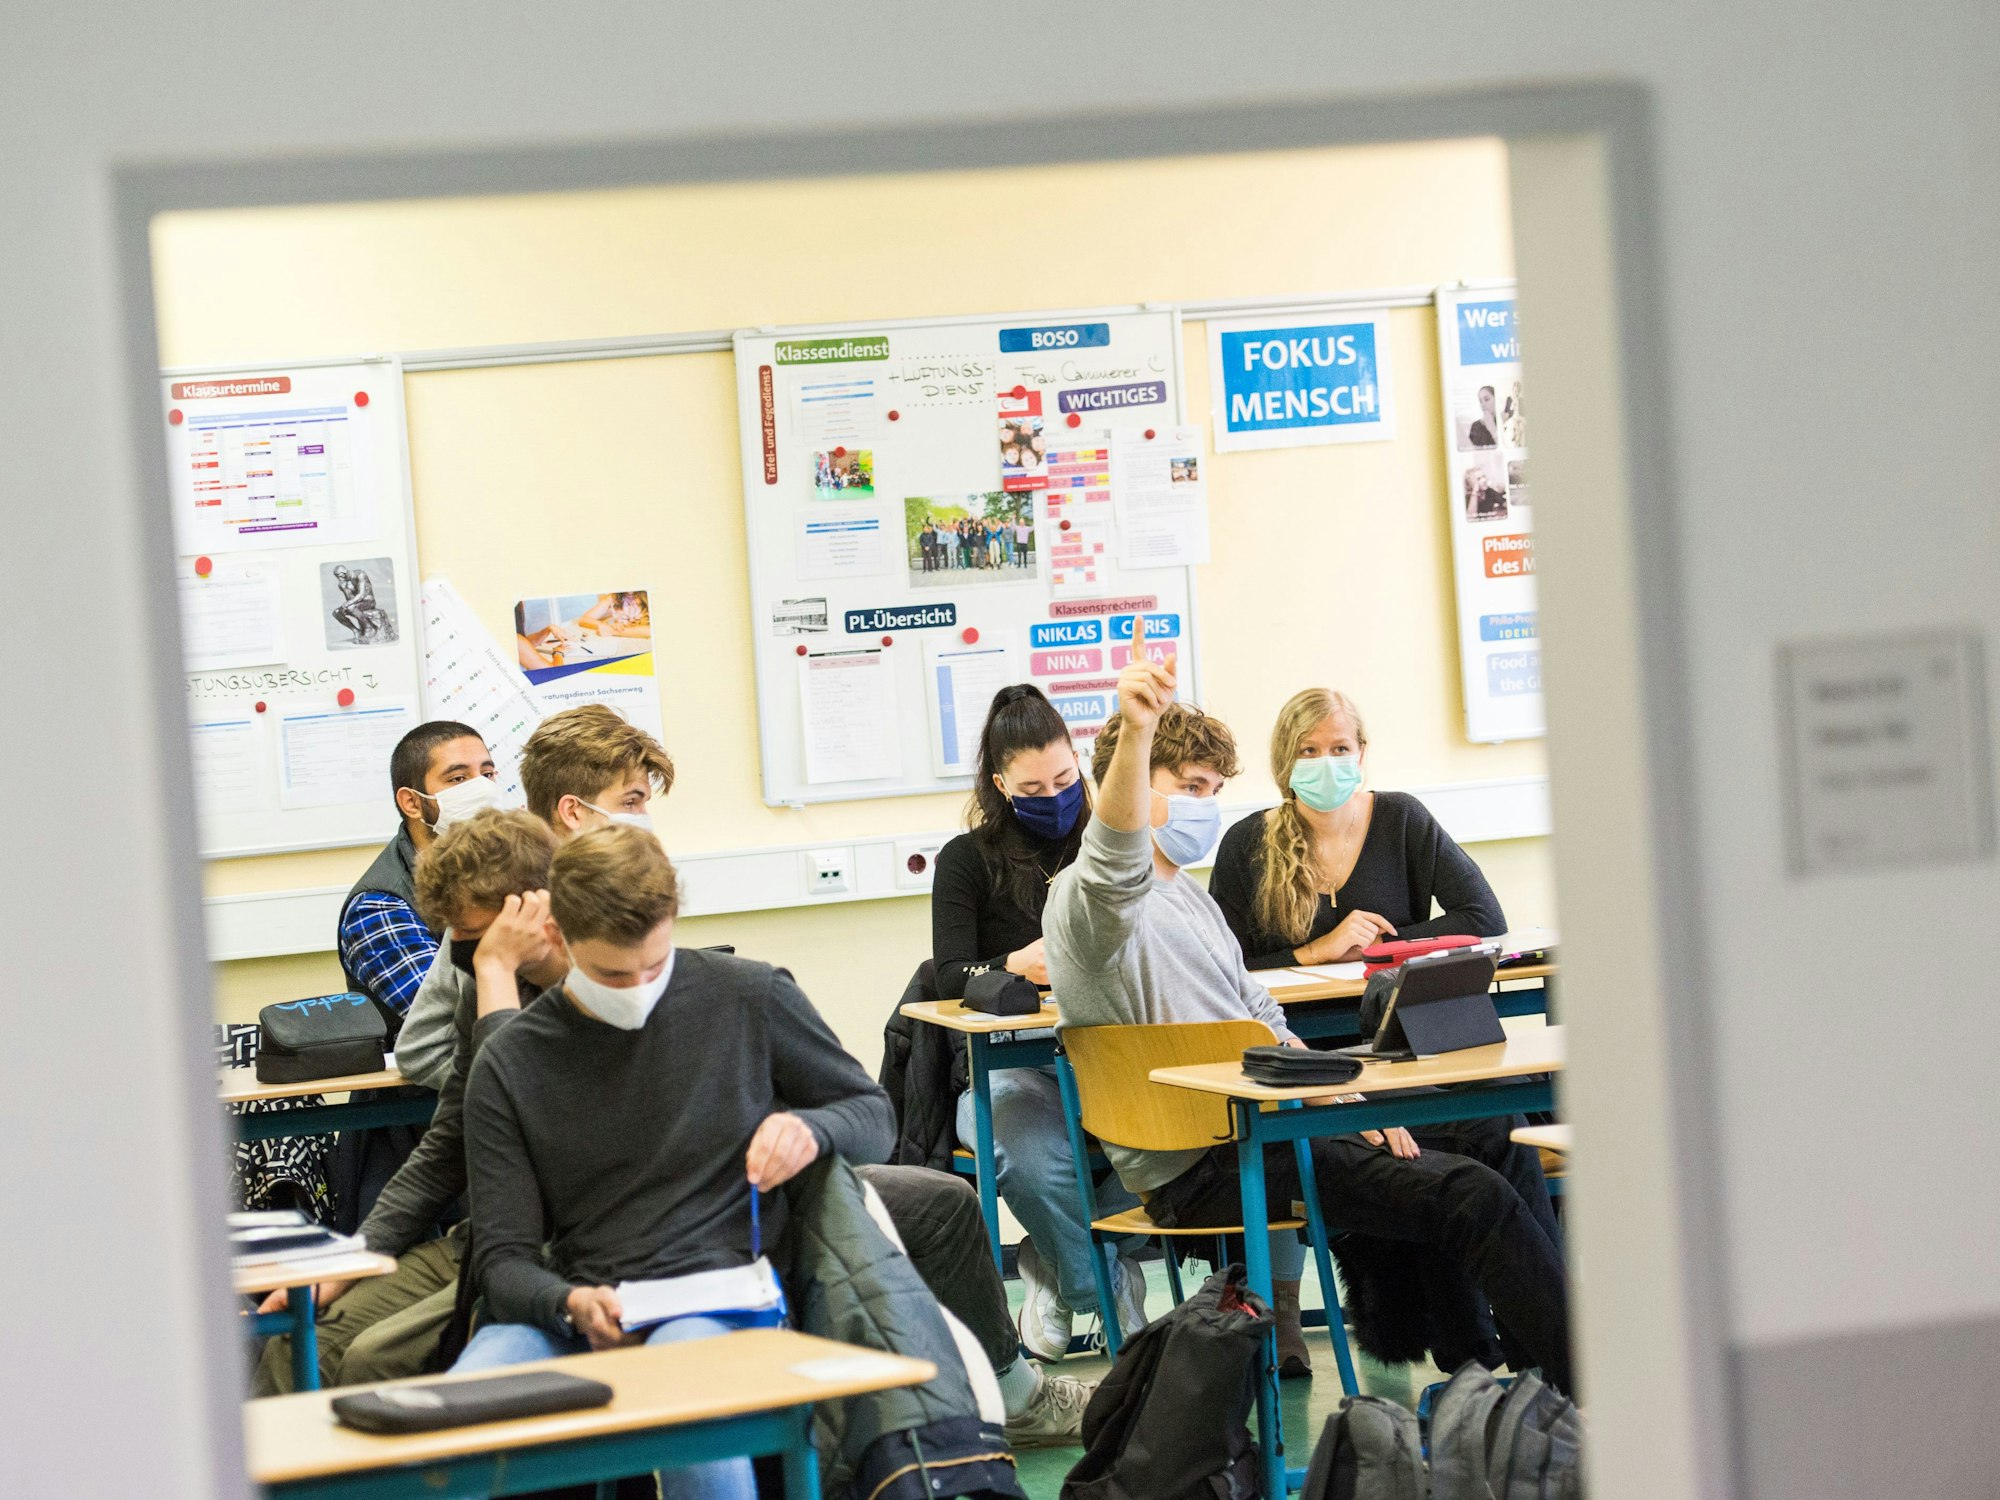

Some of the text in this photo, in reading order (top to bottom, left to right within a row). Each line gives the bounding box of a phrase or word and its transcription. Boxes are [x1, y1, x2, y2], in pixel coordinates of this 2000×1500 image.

[1463, 308, 1508, 328] Wer
[1031, 330, 1079, 348] BOSO
[776, 341, 889, 361] Klassendienst
[1243, 335, 1357, 371] FOKUS
[1014, 365, 1056, 384] Frau
[183, 380, 280, 398] Klausurtermine
[1066, 386, 1159, 410] WICHTIGES
[1231, 385, 1376, 423] MENSCH
[762, 369, 776, 480] Tafel- und Fegedienst
[1491, 558, 1520, 575] des
[1055, 598, 1153, 615] KlassensprecherIn
[849, 608, 953, 631] PL-Übersicht
[1121, 618, 1171, 635] CRIS
[1037, 625, 1097, 643] NIKLAS
[1047, 654, 1089, 671] NINA
[1491, 653, 1527, 670] Food
[1500, 677, 1525, 691] the
